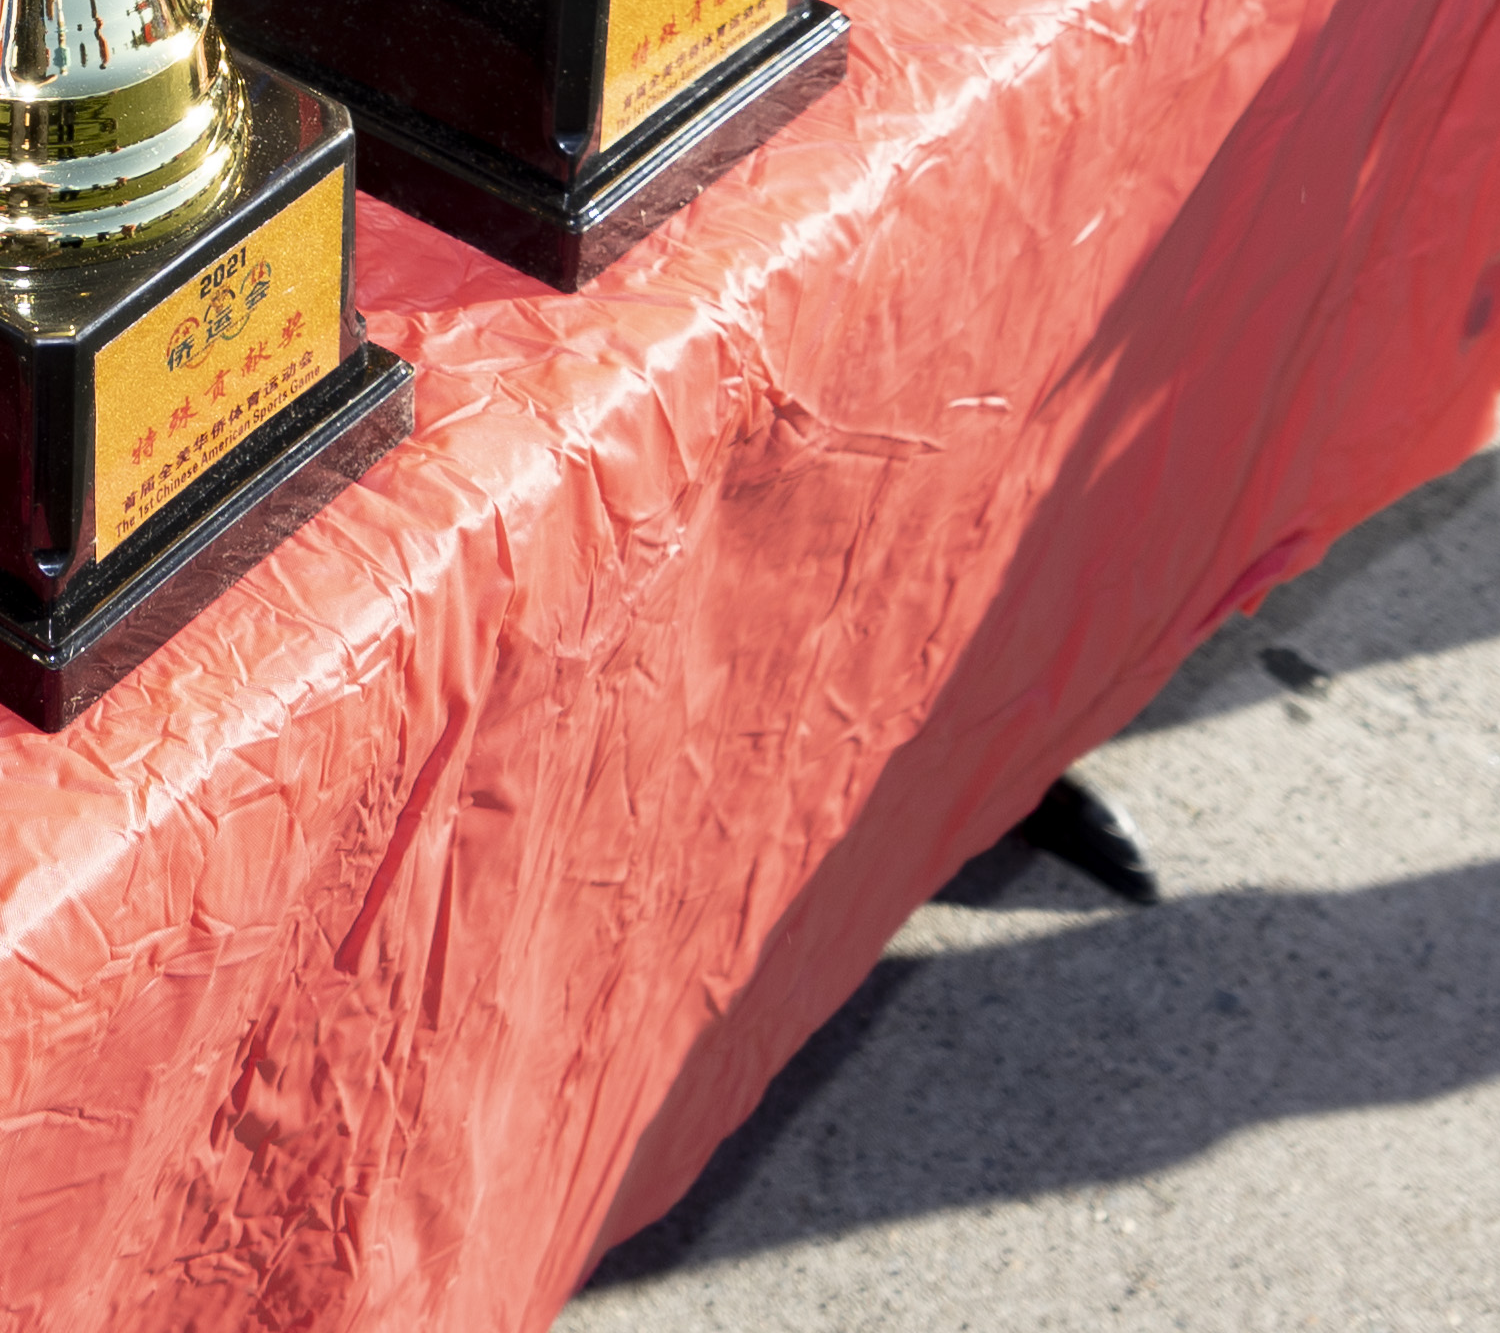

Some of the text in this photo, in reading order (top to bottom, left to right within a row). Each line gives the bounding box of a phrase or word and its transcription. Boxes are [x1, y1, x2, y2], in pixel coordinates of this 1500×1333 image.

[199, 246, 248, 300] 2021
[115, 365, 321, 538] The 1st Chinese American Sports Game
